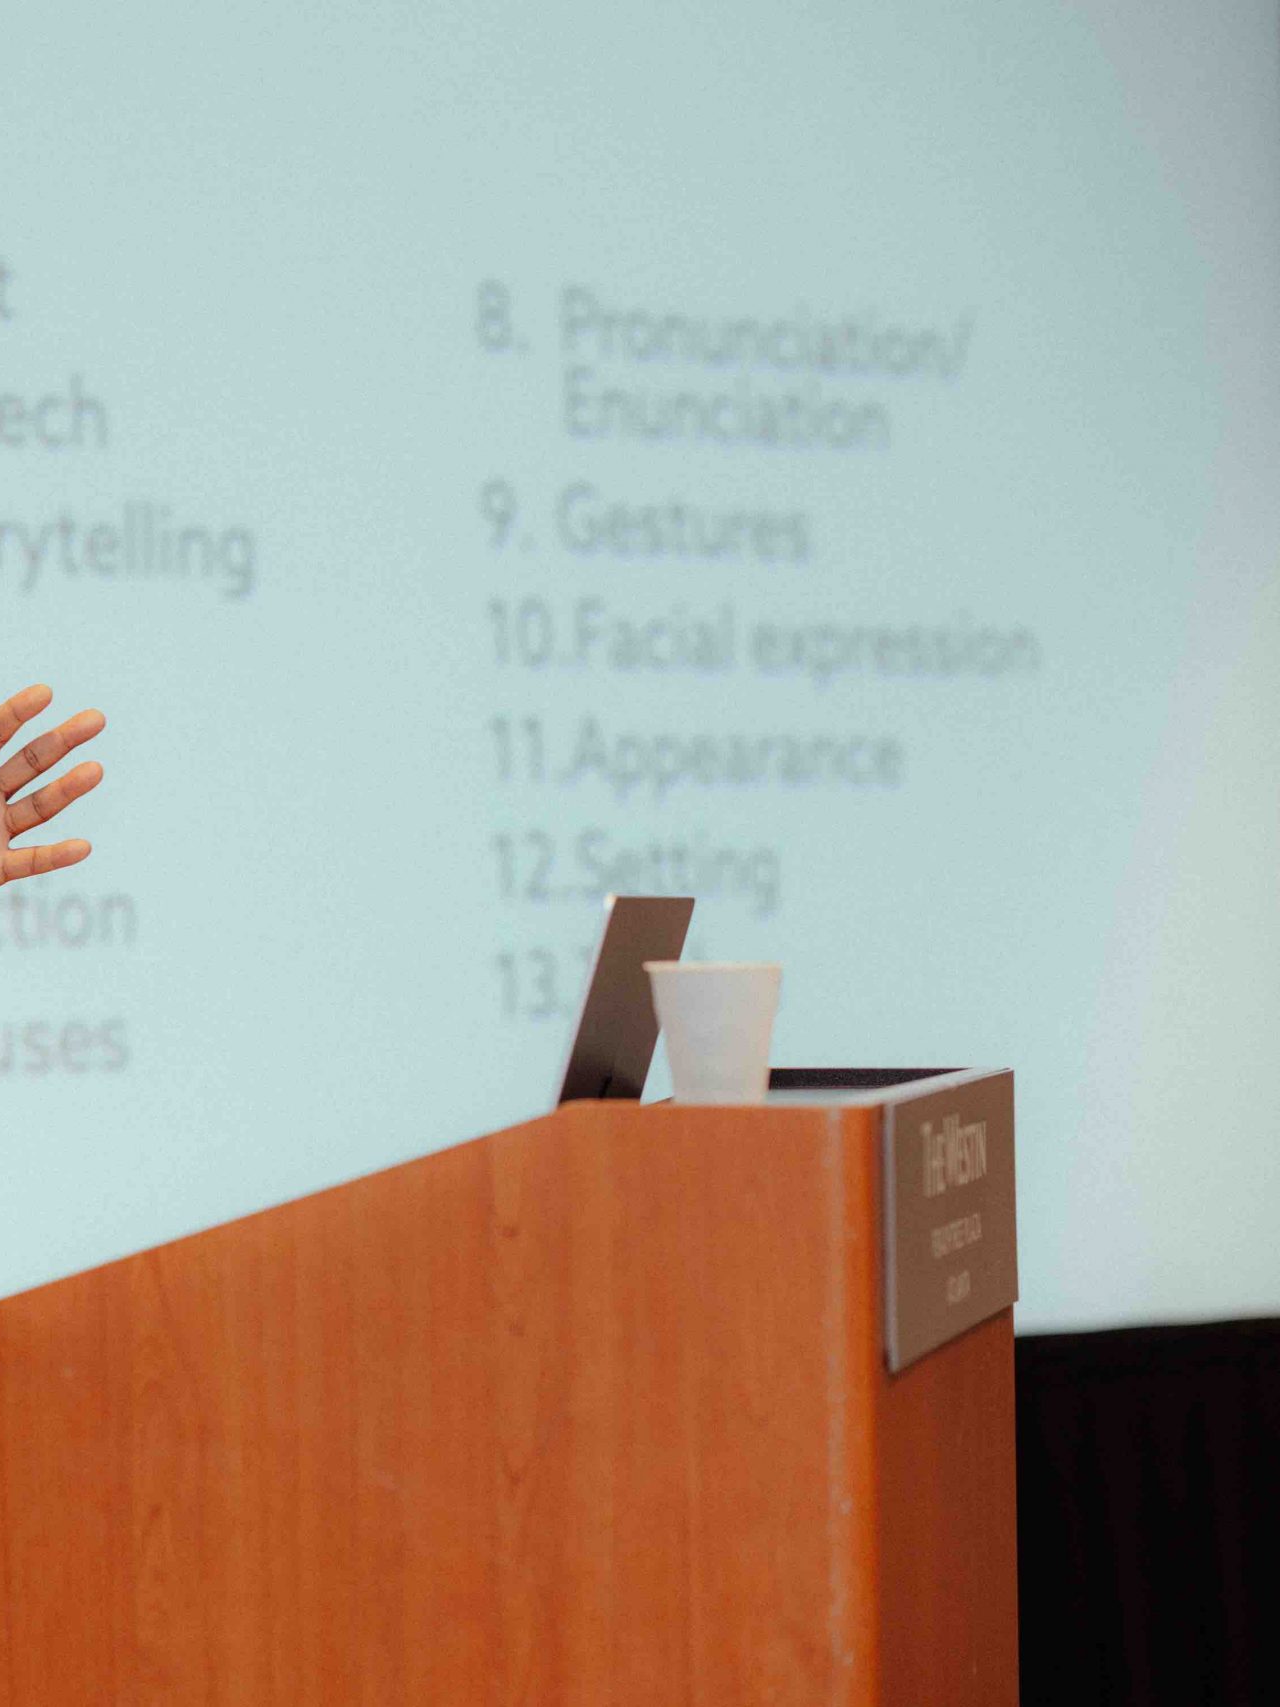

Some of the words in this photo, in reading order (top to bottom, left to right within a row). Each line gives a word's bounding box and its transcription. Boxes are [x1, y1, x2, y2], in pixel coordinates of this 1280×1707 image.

[559, 284, 980, 380] Pronunciation/
[562, 361, 895, 452] Enunciation
[555, 480, 813, 564] Gestures
[749, 606, 1043, 695] expression
